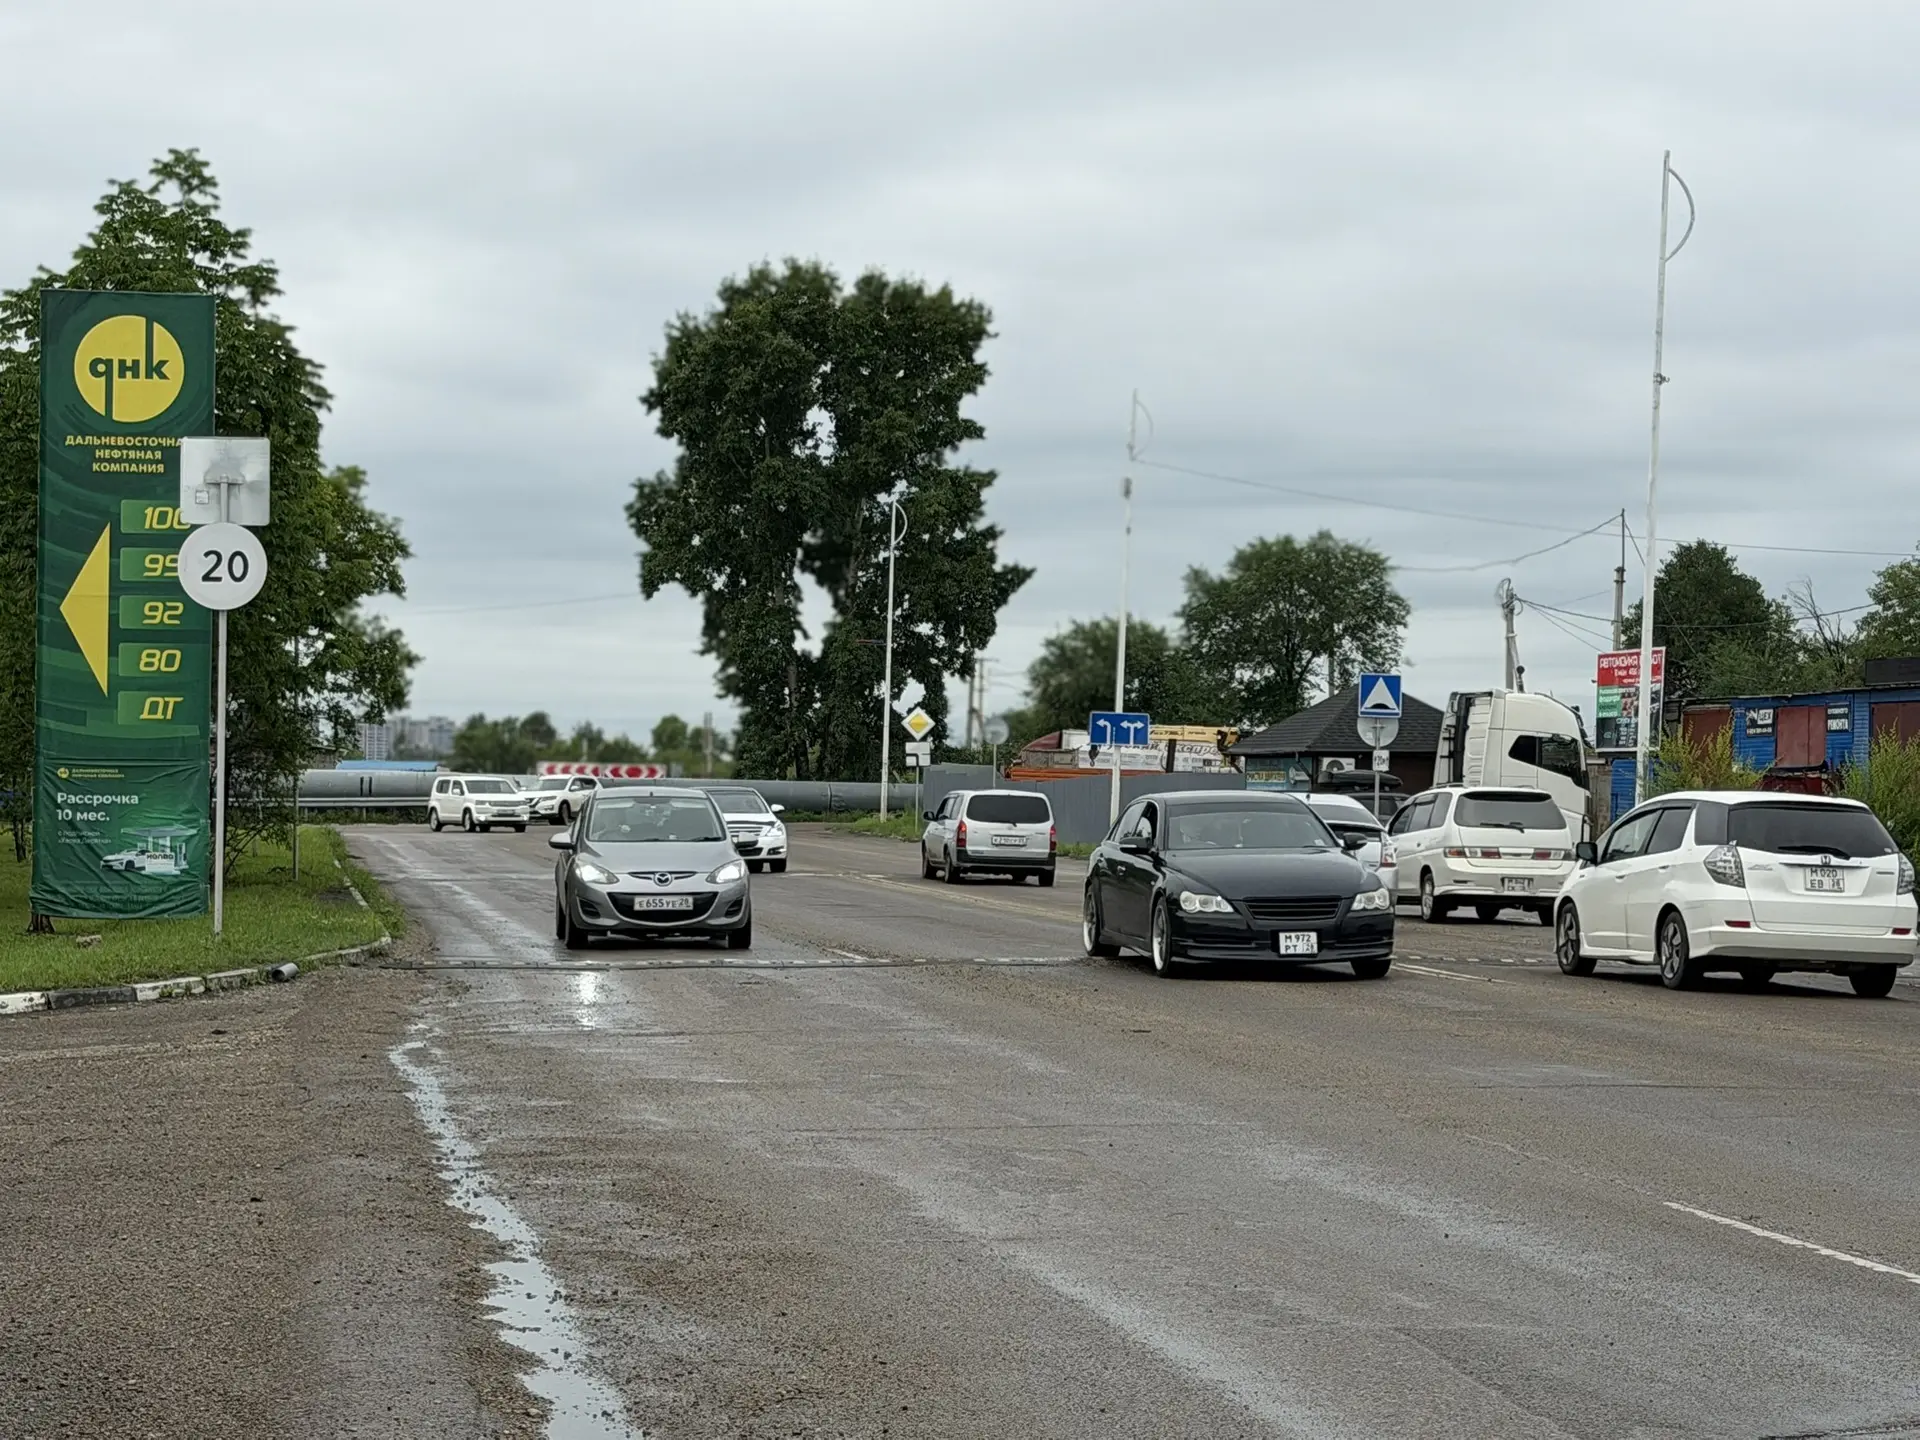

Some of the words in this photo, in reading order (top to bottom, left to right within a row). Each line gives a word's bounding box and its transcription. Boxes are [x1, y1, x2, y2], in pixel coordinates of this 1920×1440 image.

[65, 435, 184, 447] ДАЛЬНЕВОСТОЧНА
[95, 449, 162, 460] НЕФТЯНАЯ
[92, 462, 165, 473] КОМПАНИЯ
[201, 549, 249, 583] 20
[142, 602, 184, 624] 92
[139, 649, 182, 672] 80
[139, 697, 184, 720] ДТ
[57, 792, 139, 807] Рассрочка
[56, 809, 72, 821] 10
[76, 811, 110, 821] мес.
